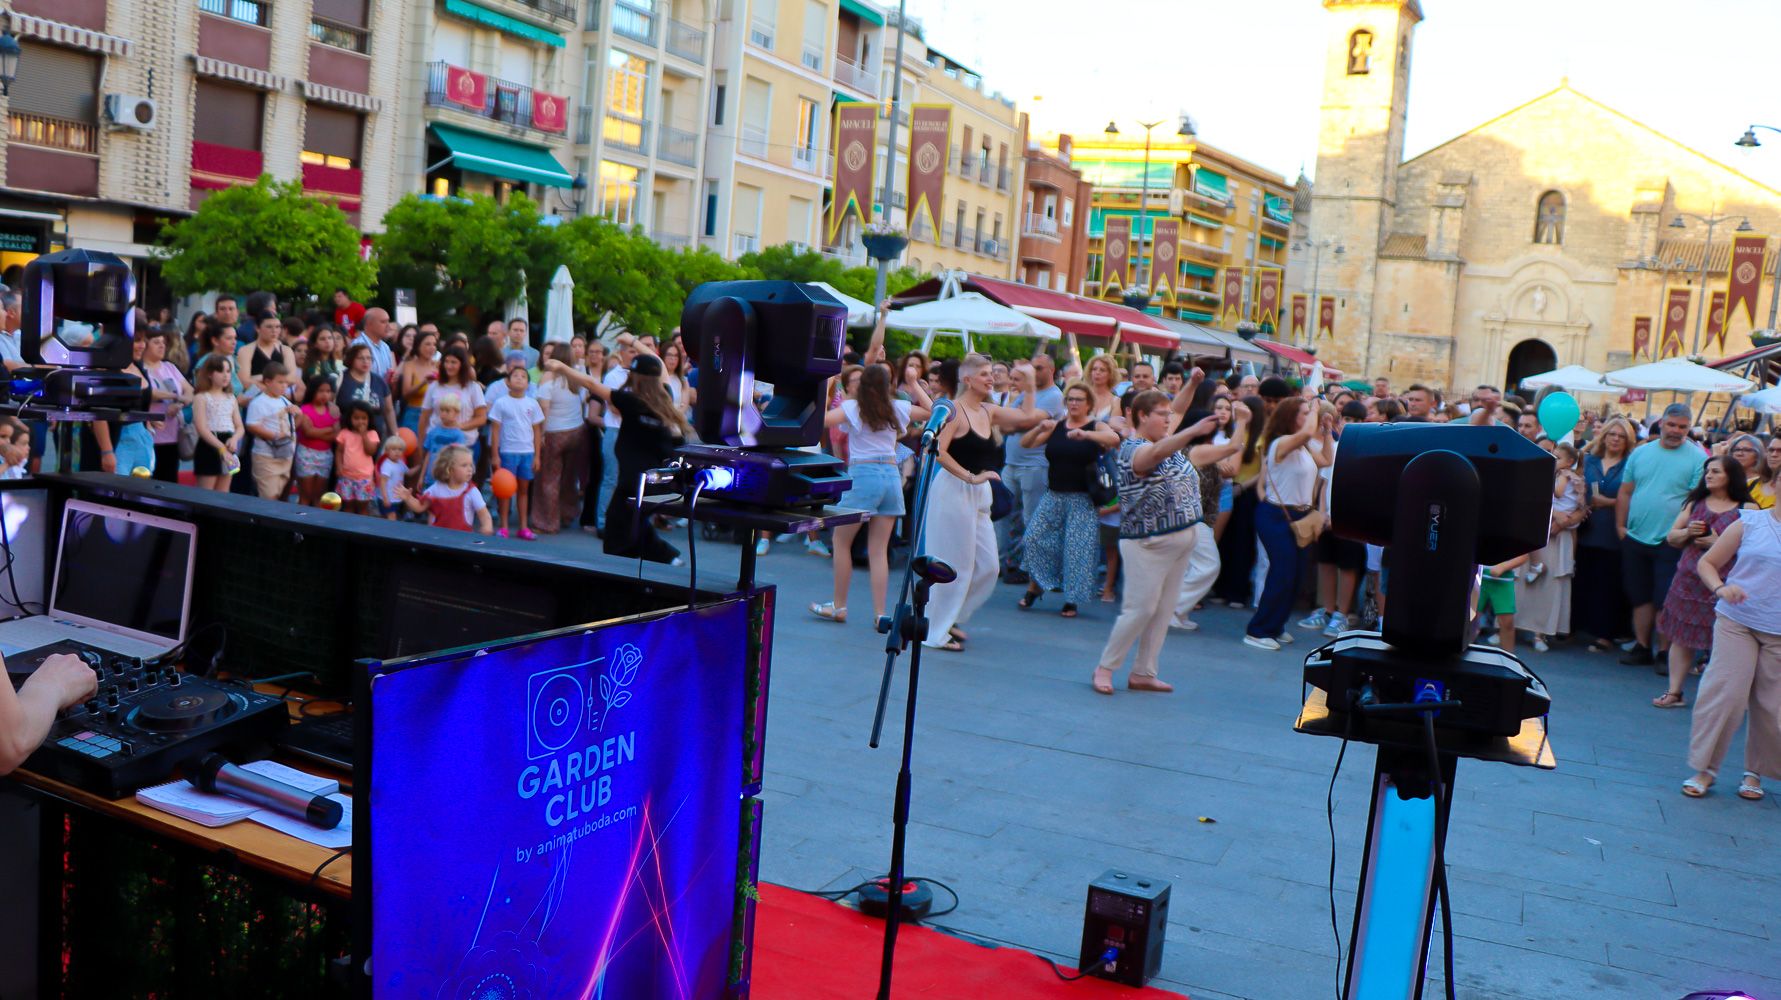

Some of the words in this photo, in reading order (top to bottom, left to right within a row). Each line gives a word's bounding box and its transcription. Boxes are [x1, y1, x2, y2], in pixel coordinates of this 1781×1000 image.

[841, 119, 876, 129] ARACELI
[517, 731, 635, 799] GARDEN
[545, 774, 612, 827] CLUB
[516, 846, 533, 863] by
[537, 805, 637, 856] animatuboda.com
